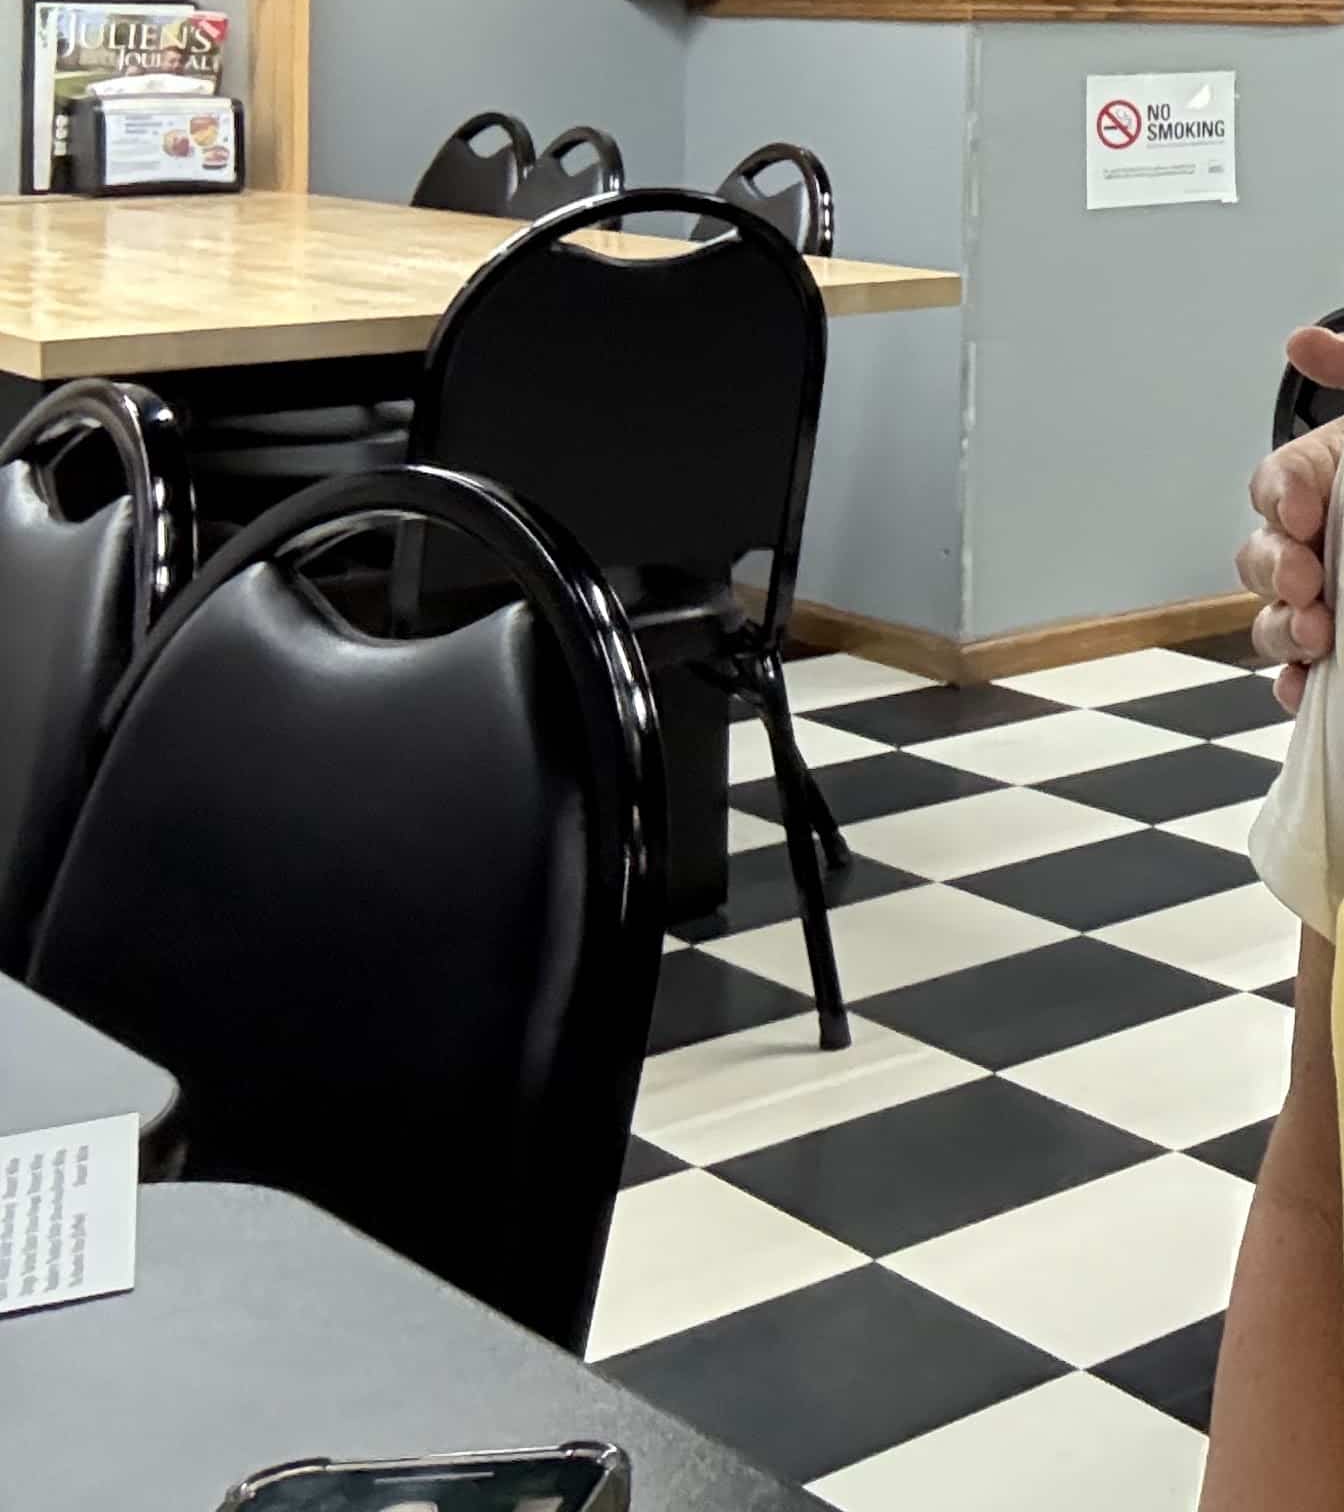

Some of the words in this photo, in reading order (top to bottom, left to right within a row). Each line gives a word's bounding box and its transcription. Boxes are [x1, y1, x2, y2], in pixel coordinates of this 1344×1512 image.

[63, 10, 212, 57] JULIEN'S
[118, 44, 211, 72] JOUAL
[1146, 103, 1171, 122] NO
[1146, 120, 1226, 141] SMOKING
